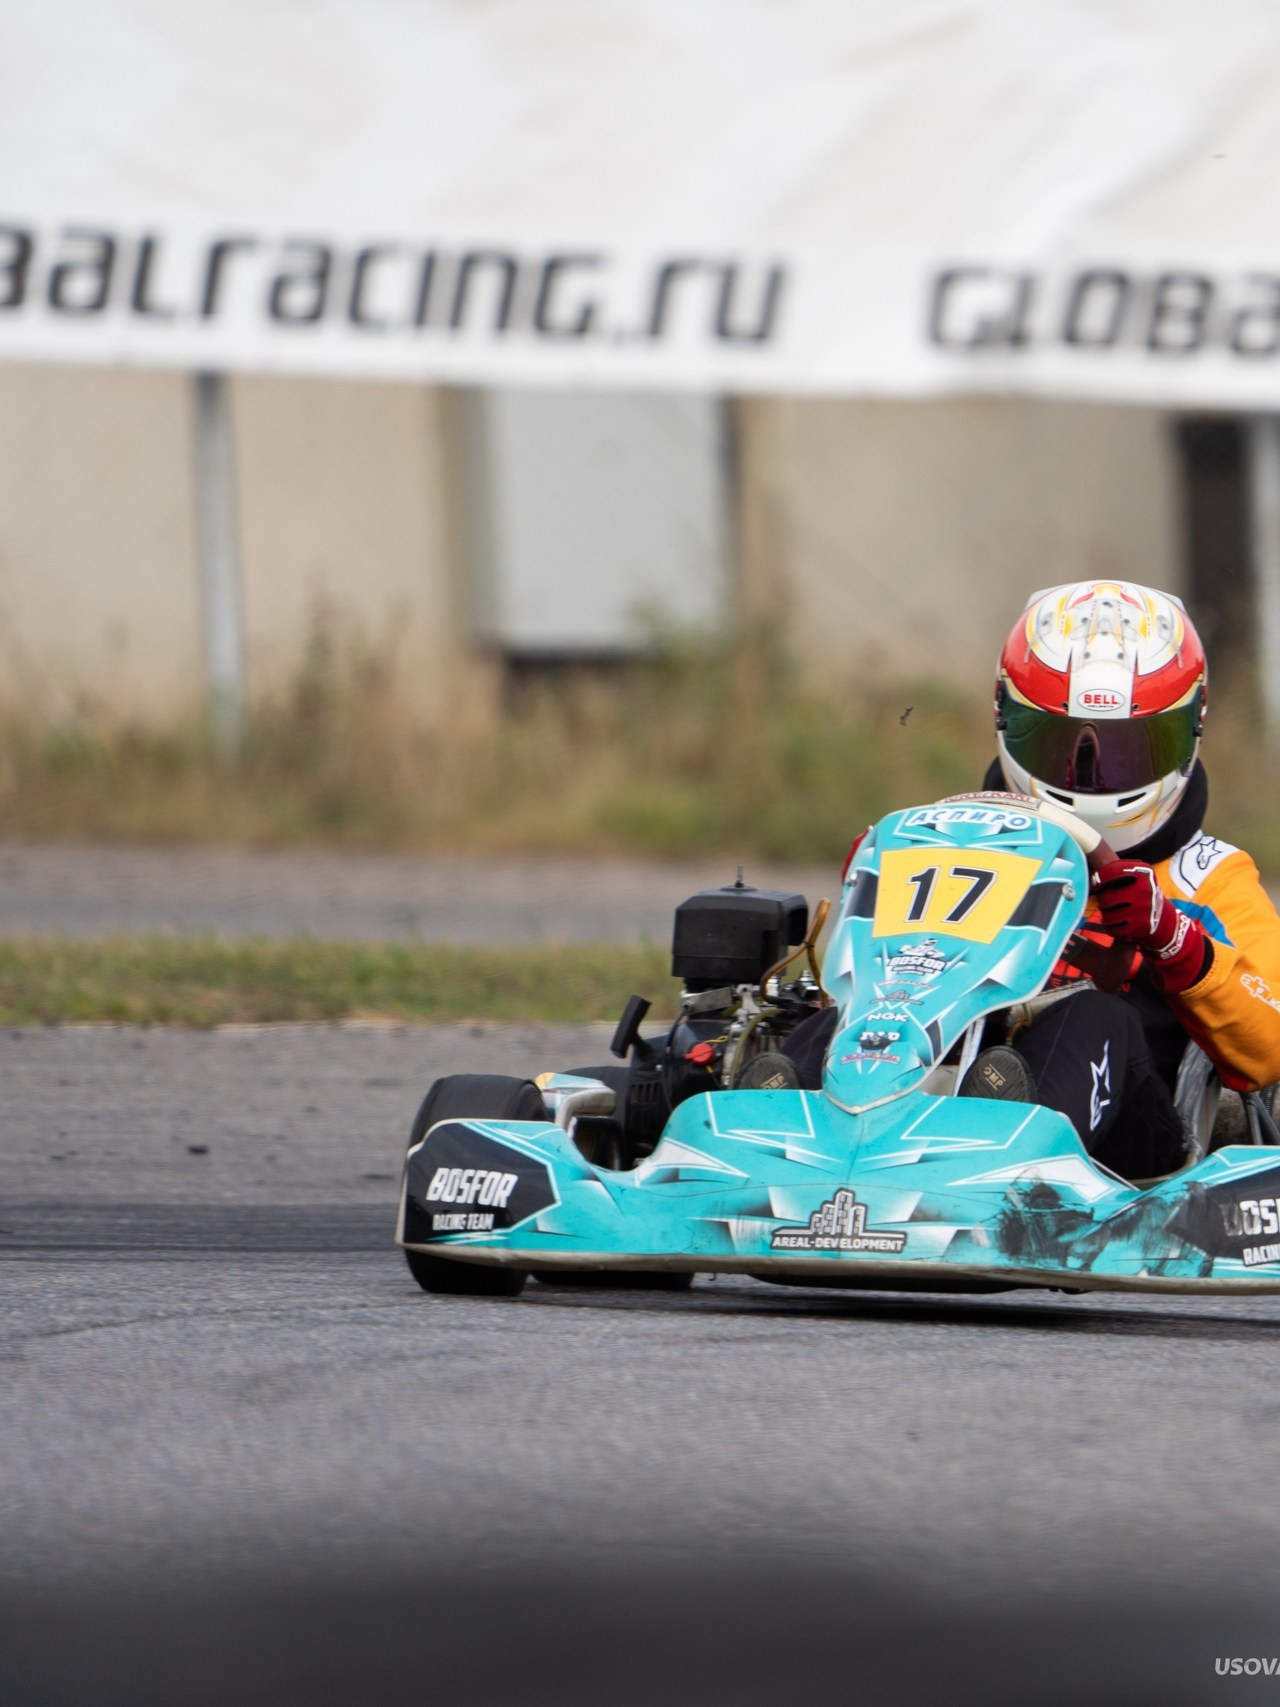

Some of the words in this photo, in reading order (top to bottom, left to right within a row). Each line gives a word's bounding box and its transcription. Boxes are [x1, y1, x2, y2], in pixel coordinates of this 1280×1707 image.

[1083, 694, 1119, 705] BELL
[909, 810, 1028, 828] АСПИРО
[904, 866, 998, 924] 17
[887, 954, 947, 972] BOSFOR
[867, 1011, 909, 1022] NGK
[983, 1065, 1004, 1087] OMP
[426, 1167, 518, 1208] BOSFOR
[432, 1214, 467, 1231] RACING
[467, 1213, 495, 1230] TEAM
[771, 1236, 905, 1252] AREAL-DEVELOPMENT
